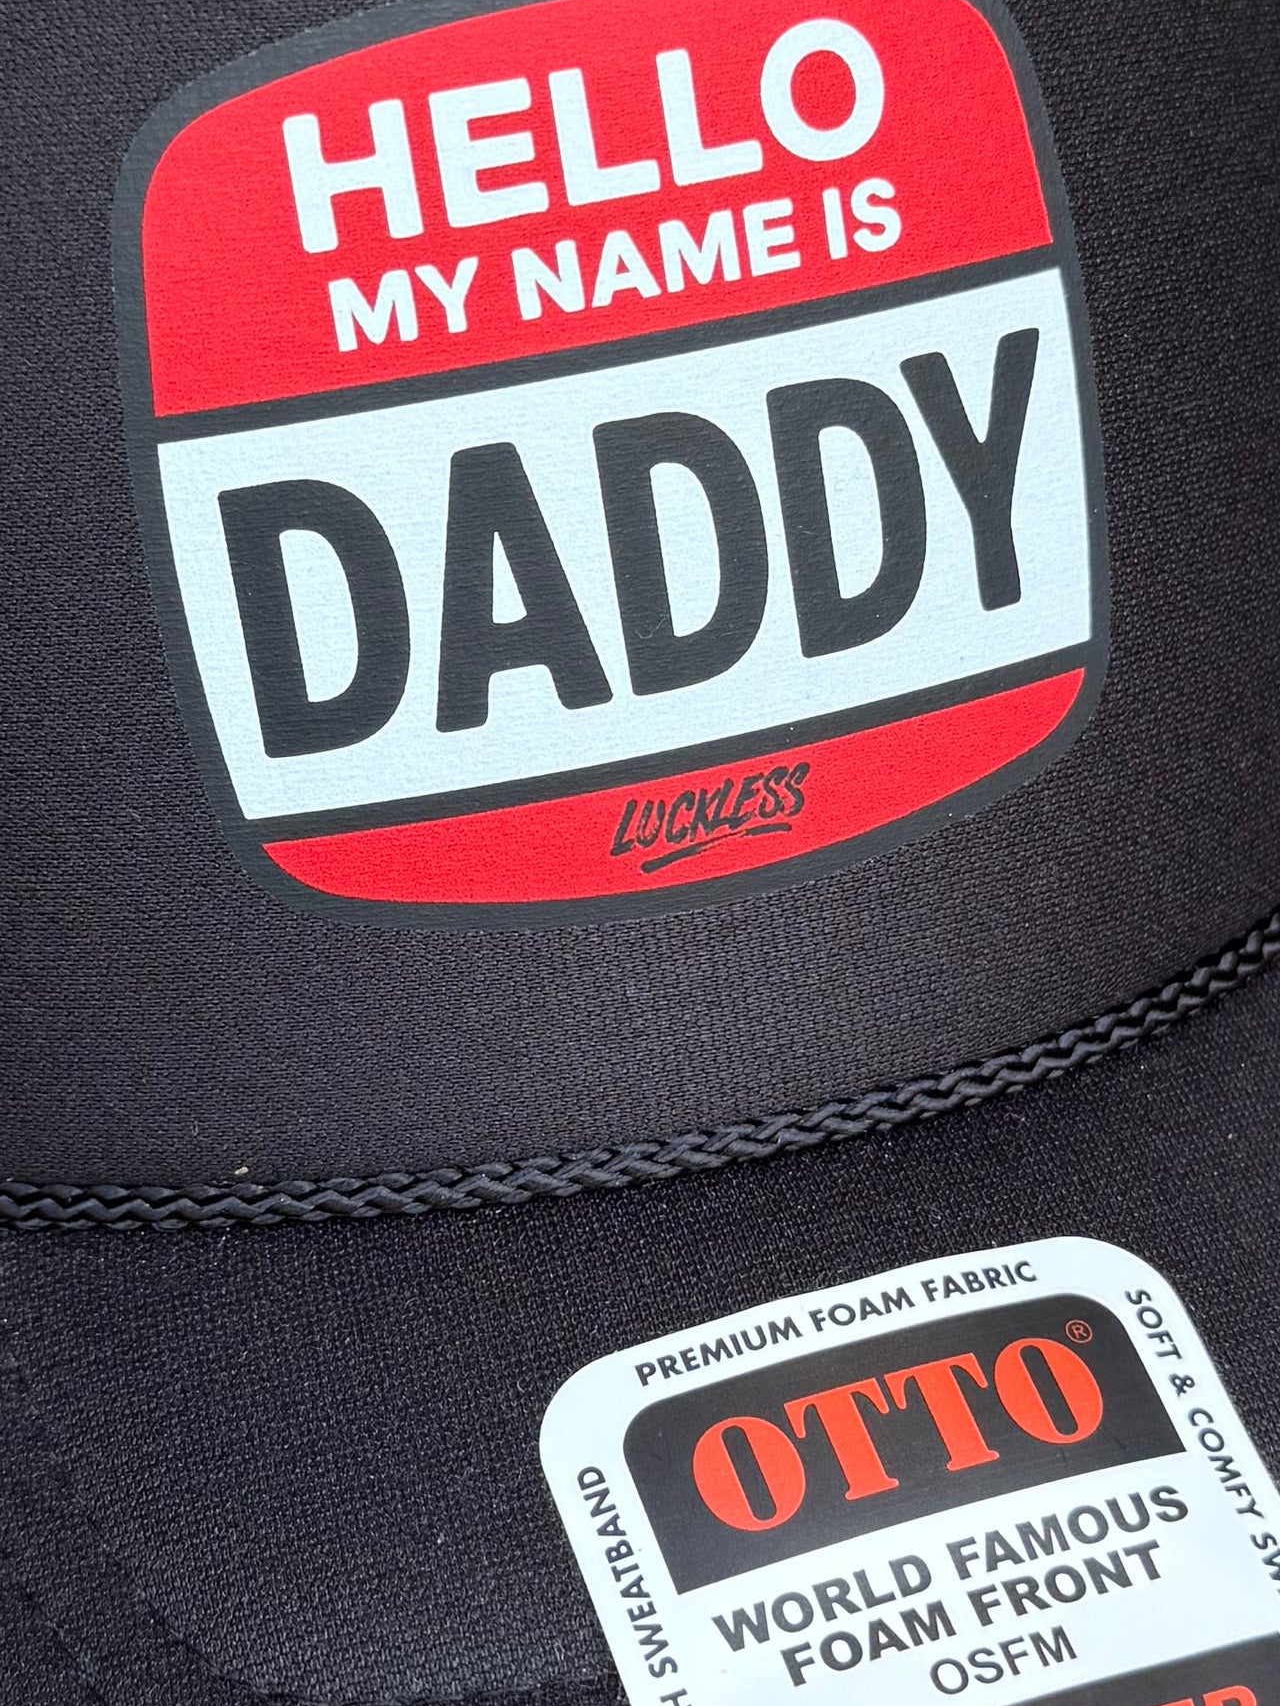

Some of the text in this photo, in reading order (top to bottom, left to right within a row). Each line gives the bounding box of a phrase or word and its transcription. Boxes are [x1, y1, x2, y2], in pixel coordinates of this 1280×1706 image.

[282, 18, 884, 253] HELLO
[329, 179, 902, 353] MY NAME IS
[218, 328, 1039, 758] DADDY
[611, 762, 809, 857] LUCKLESS
[635, 1261, 1038, 1387] PREMIUM FOAM FABRIC
[1125, 1288, 1182, 1365] SOFT
[1172, 1373, 1198, 1397] &
[1188, 1407, 1265, 1521] COMFY
[578, 1465, 678, 1675] SWEATBAND
[712, 1485, 1188, 1652] WORLD FAMOUS
[786, 1541, 1164, 1687] FOAM FRONT
[930, 1627, 1078, 1695] OSFM
